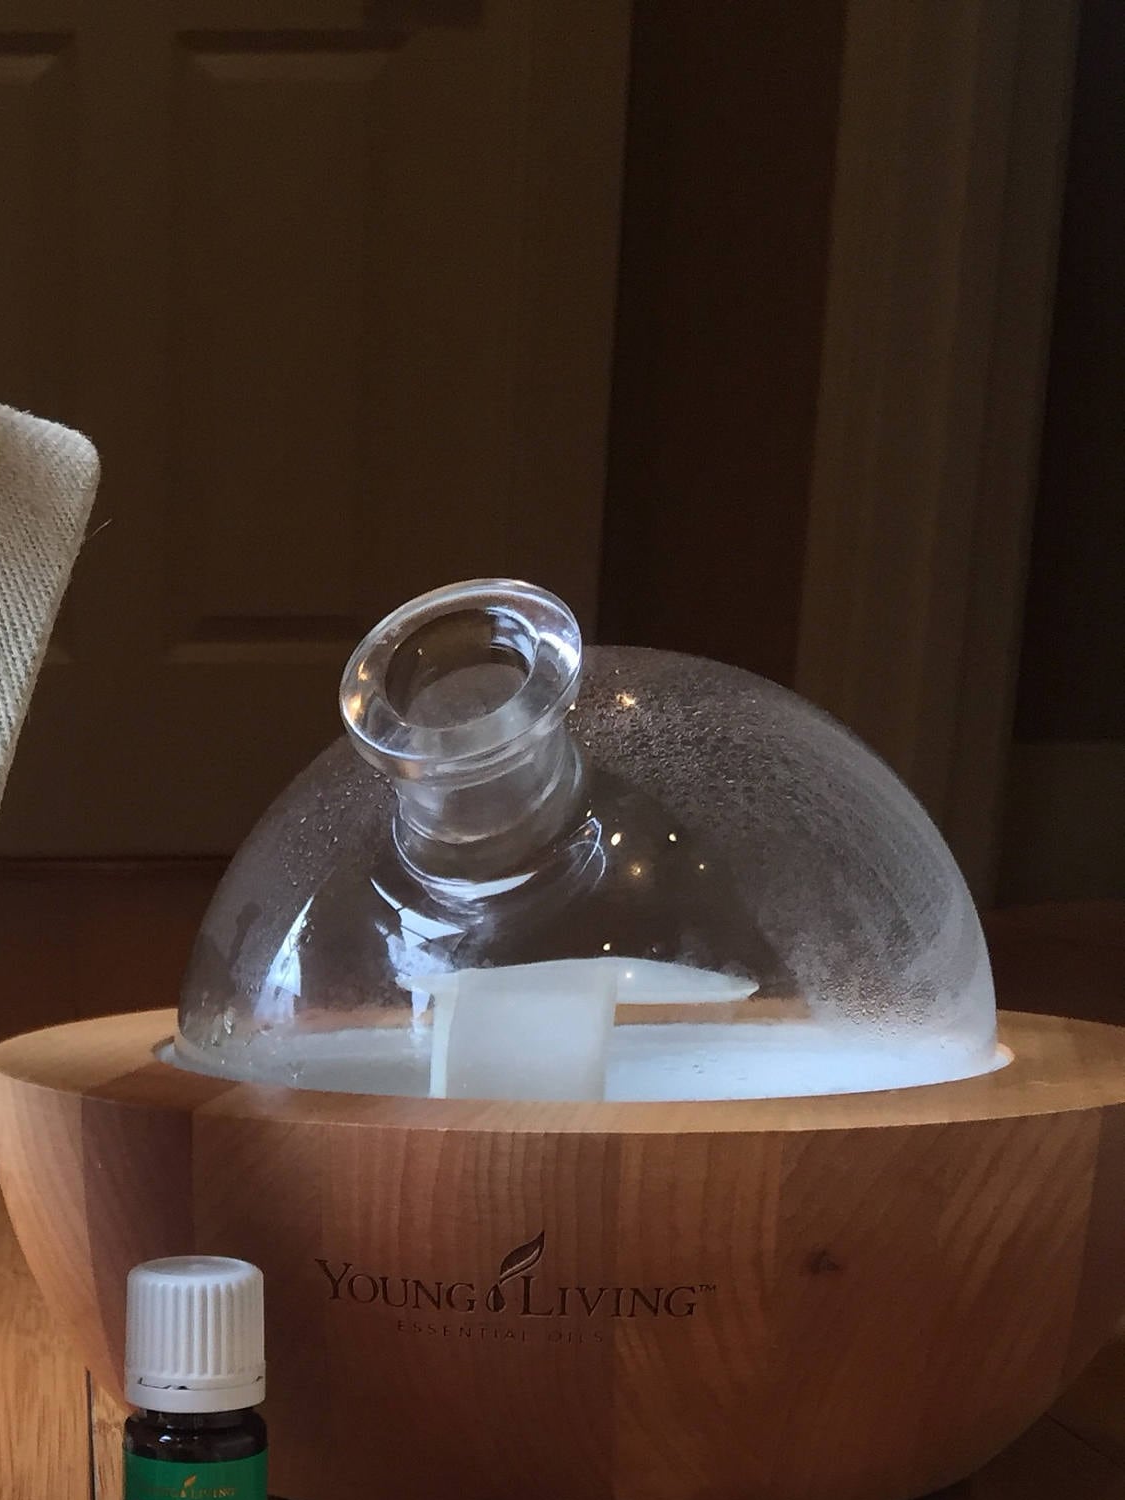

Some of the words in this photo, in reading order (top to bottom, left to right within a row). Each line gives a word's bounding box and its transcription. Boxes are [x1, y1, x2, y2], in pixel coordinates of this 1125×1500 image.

[314, 1258, 476, 1313] YOUNG
[519, 1275, 699, 1319] LIVING
[397, 1319, 528, 1343] ESSENTIAL
